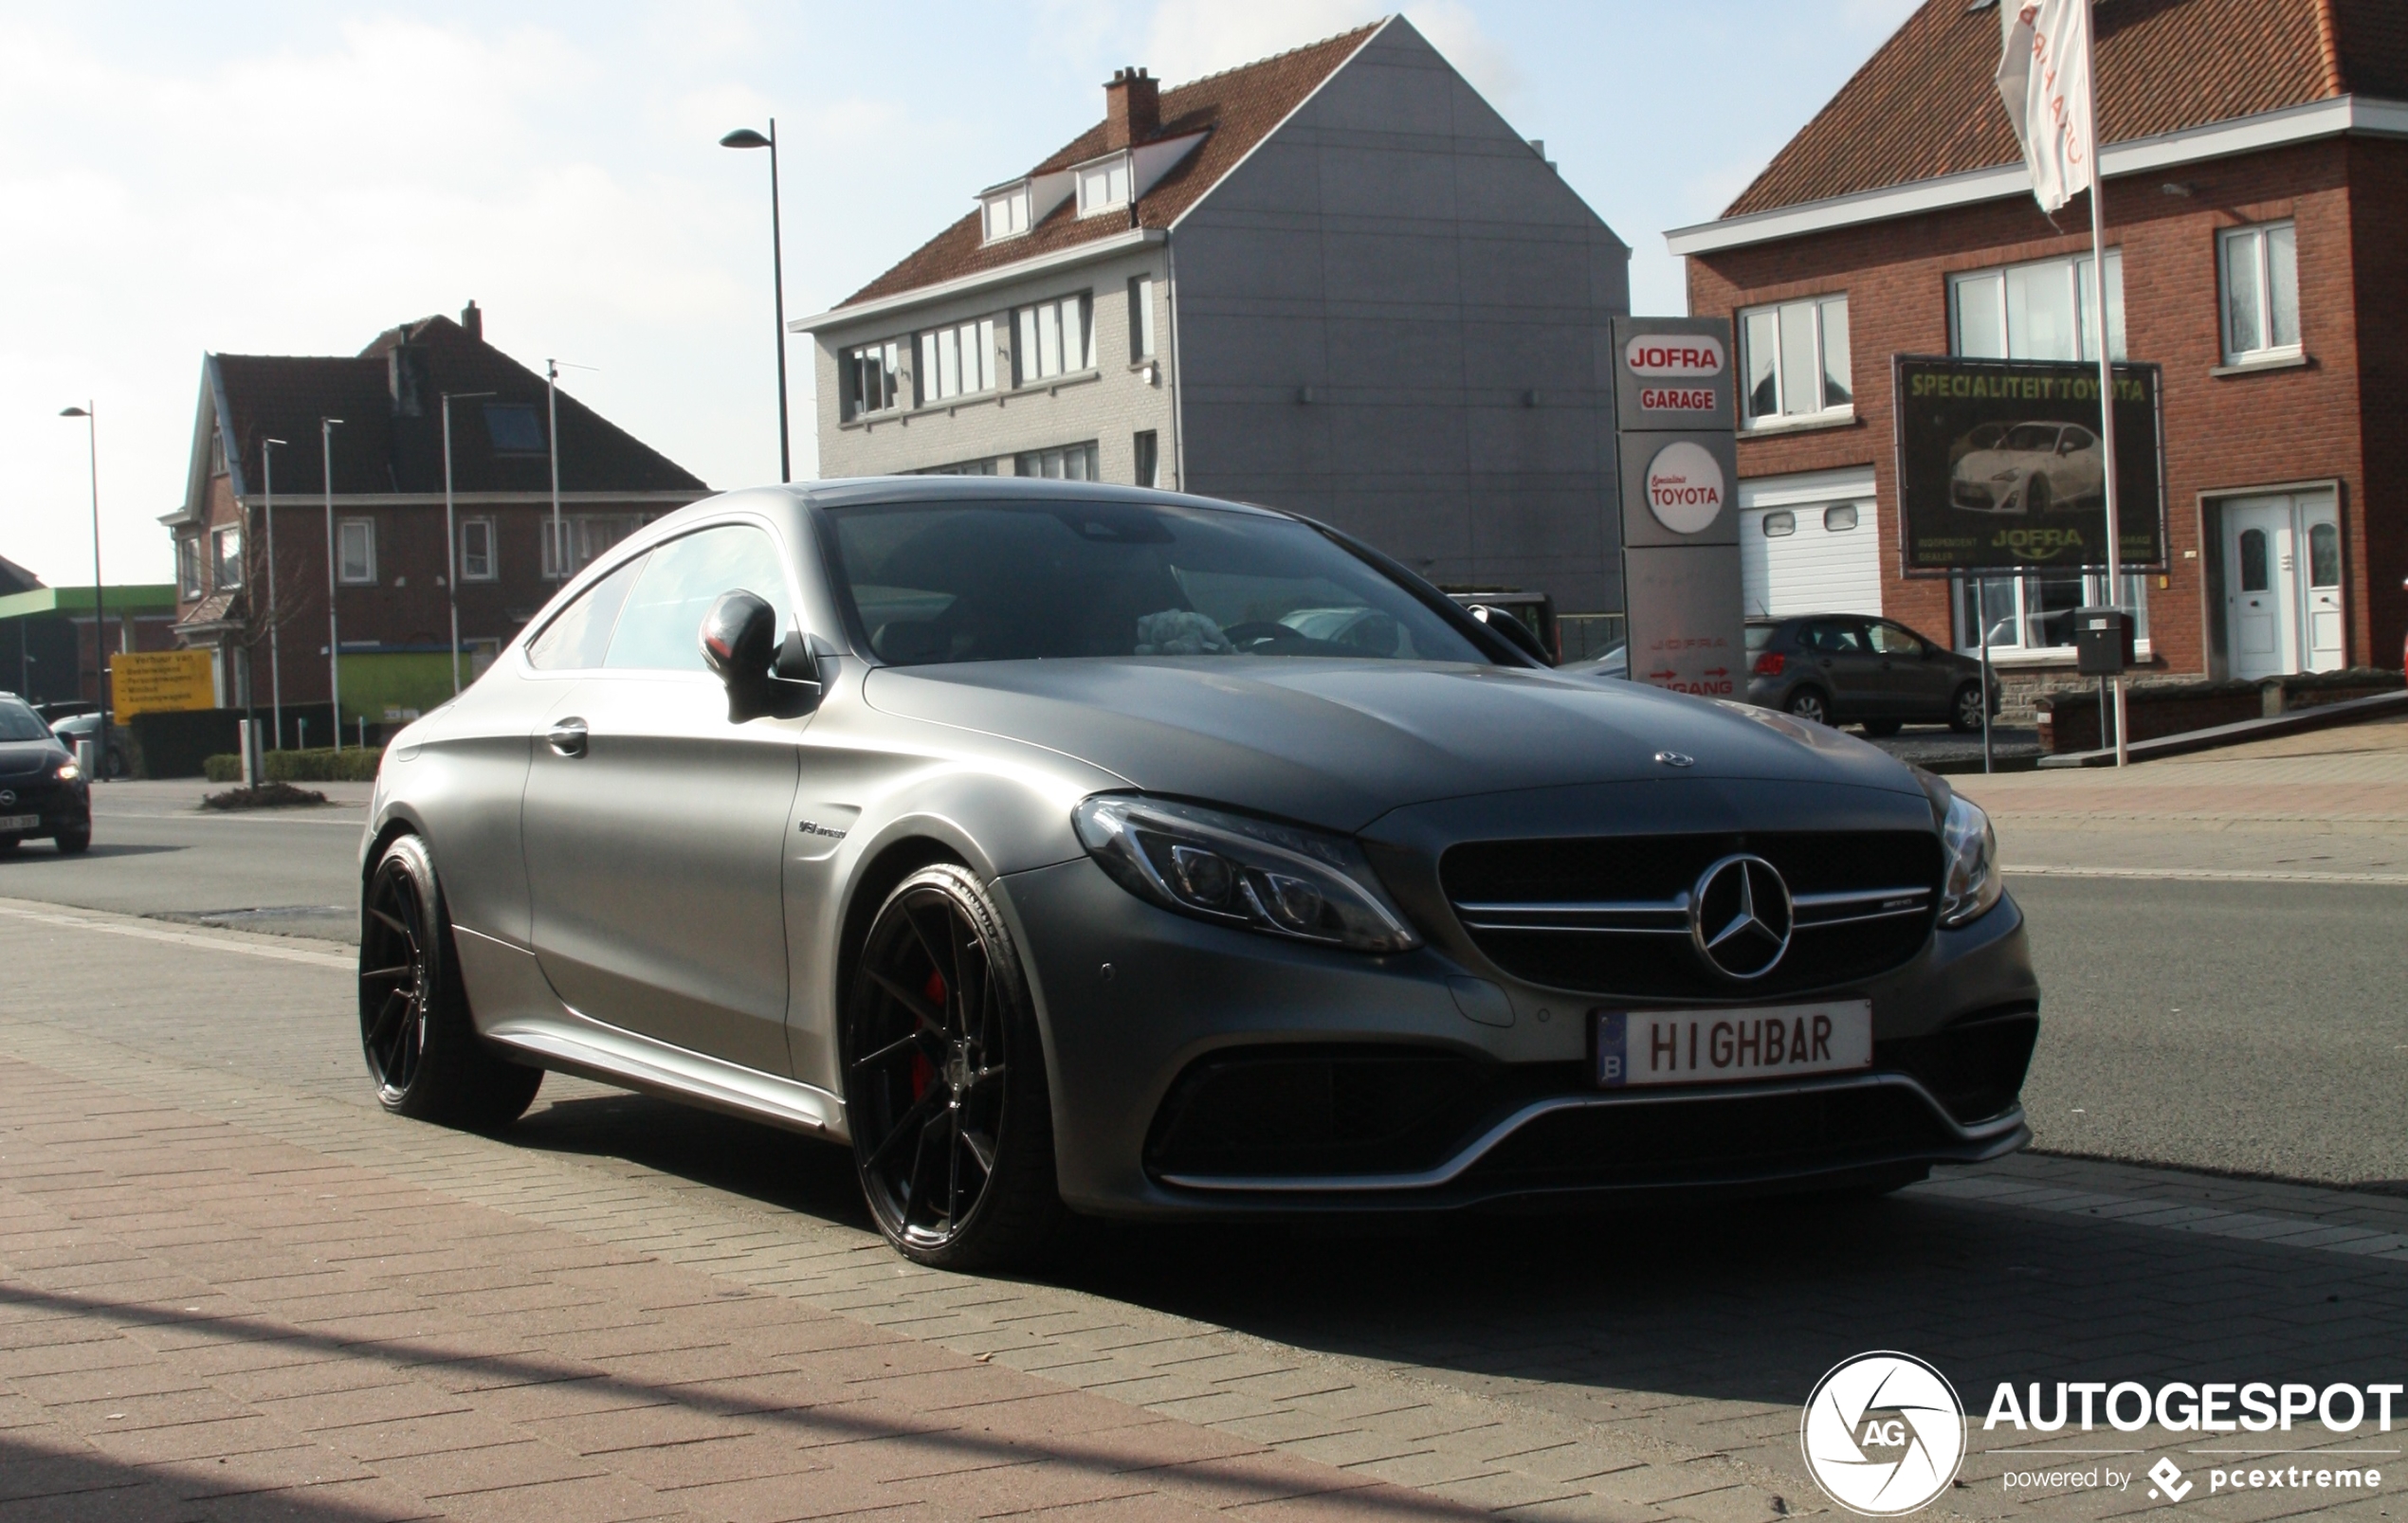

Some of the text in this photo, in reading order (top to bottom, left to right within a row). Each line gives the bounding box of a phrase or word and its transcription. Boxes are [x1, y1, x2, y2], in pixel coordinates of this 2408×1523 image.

[1630, 348, 1718, 368] JOFRA
[1911, 373, 2054, 399] SPECIALITEIT
[1642, 390, 1714, 409] GARAGE
[1651, 487, 1719, 506] TOYOTA
[1991, 528, 2083, 547] JOFRA
[1651, 637, 1728, 651] JOFRA
[1655, 680, 1733, 696] GANG
[1651, 1015, 1833, 1071] HIGHBAR
[1604, 1057, 1620, 1079] B
